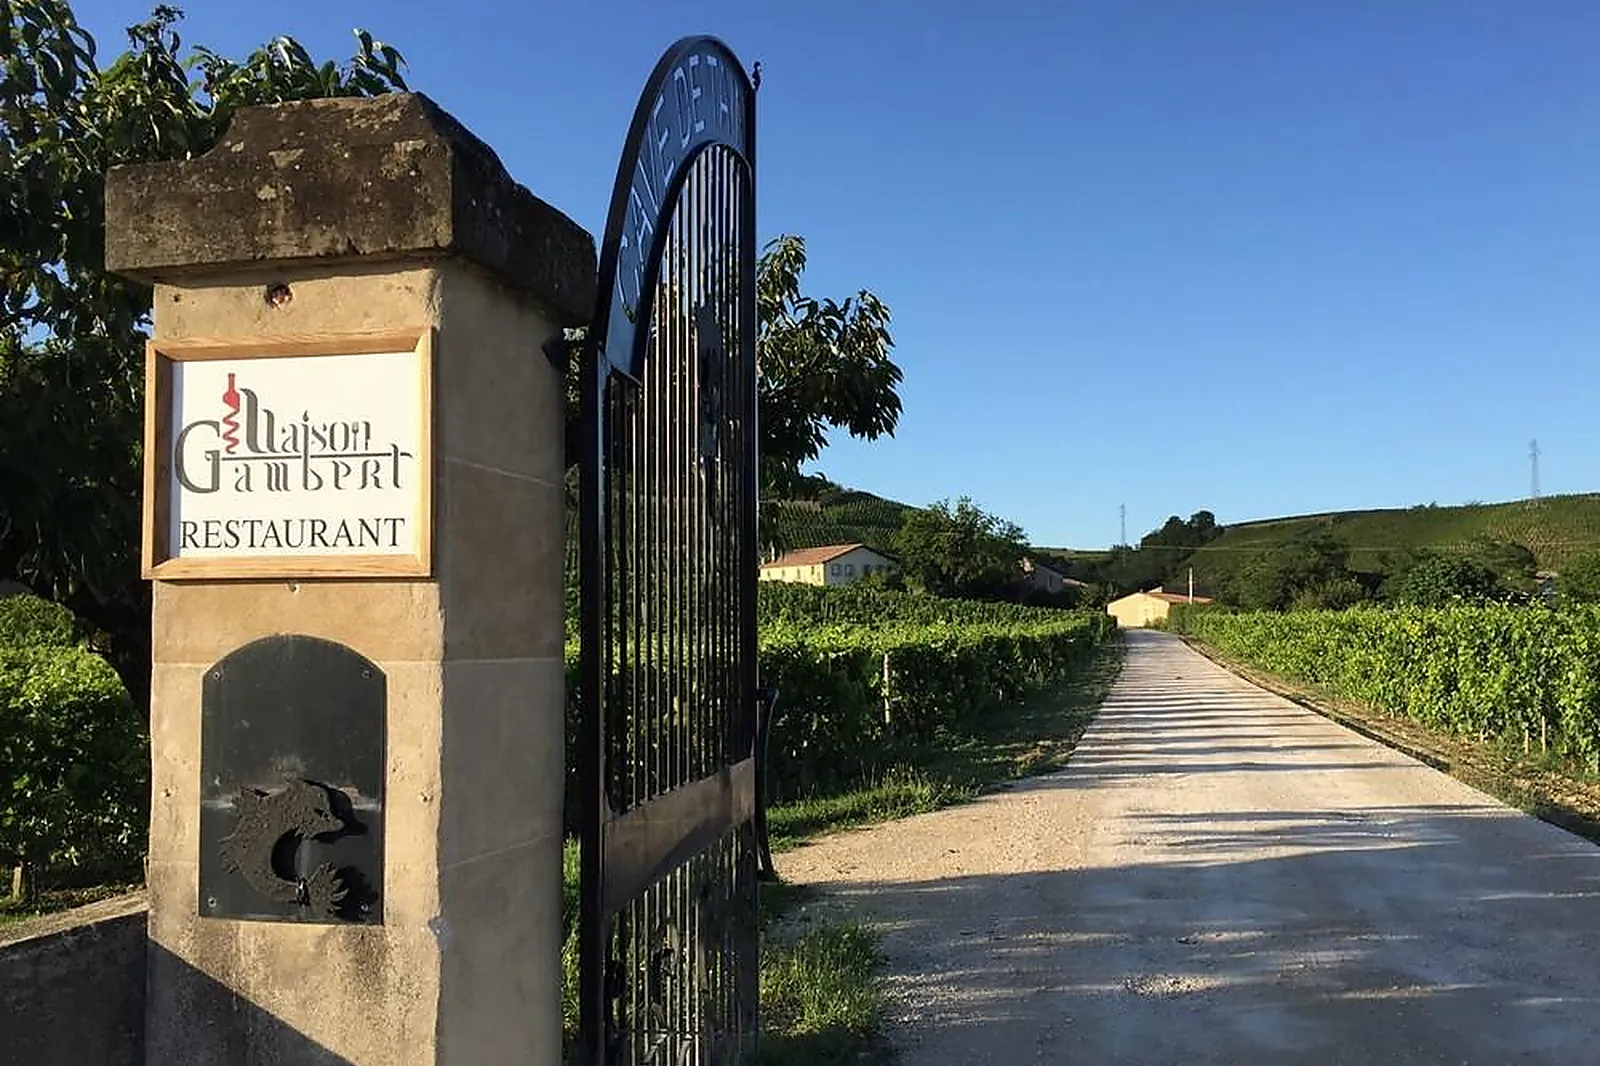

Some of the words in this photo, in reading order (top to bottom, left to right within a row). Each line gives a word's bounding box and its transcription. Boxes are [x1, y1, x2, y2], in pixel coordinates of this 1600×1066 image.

[616, 94, 675, 324] CAVE
[674, 54, 705, 148] DE
[240, 387, 371, 453] Maison
[180, 518, 405, 548] RESTAURANT
